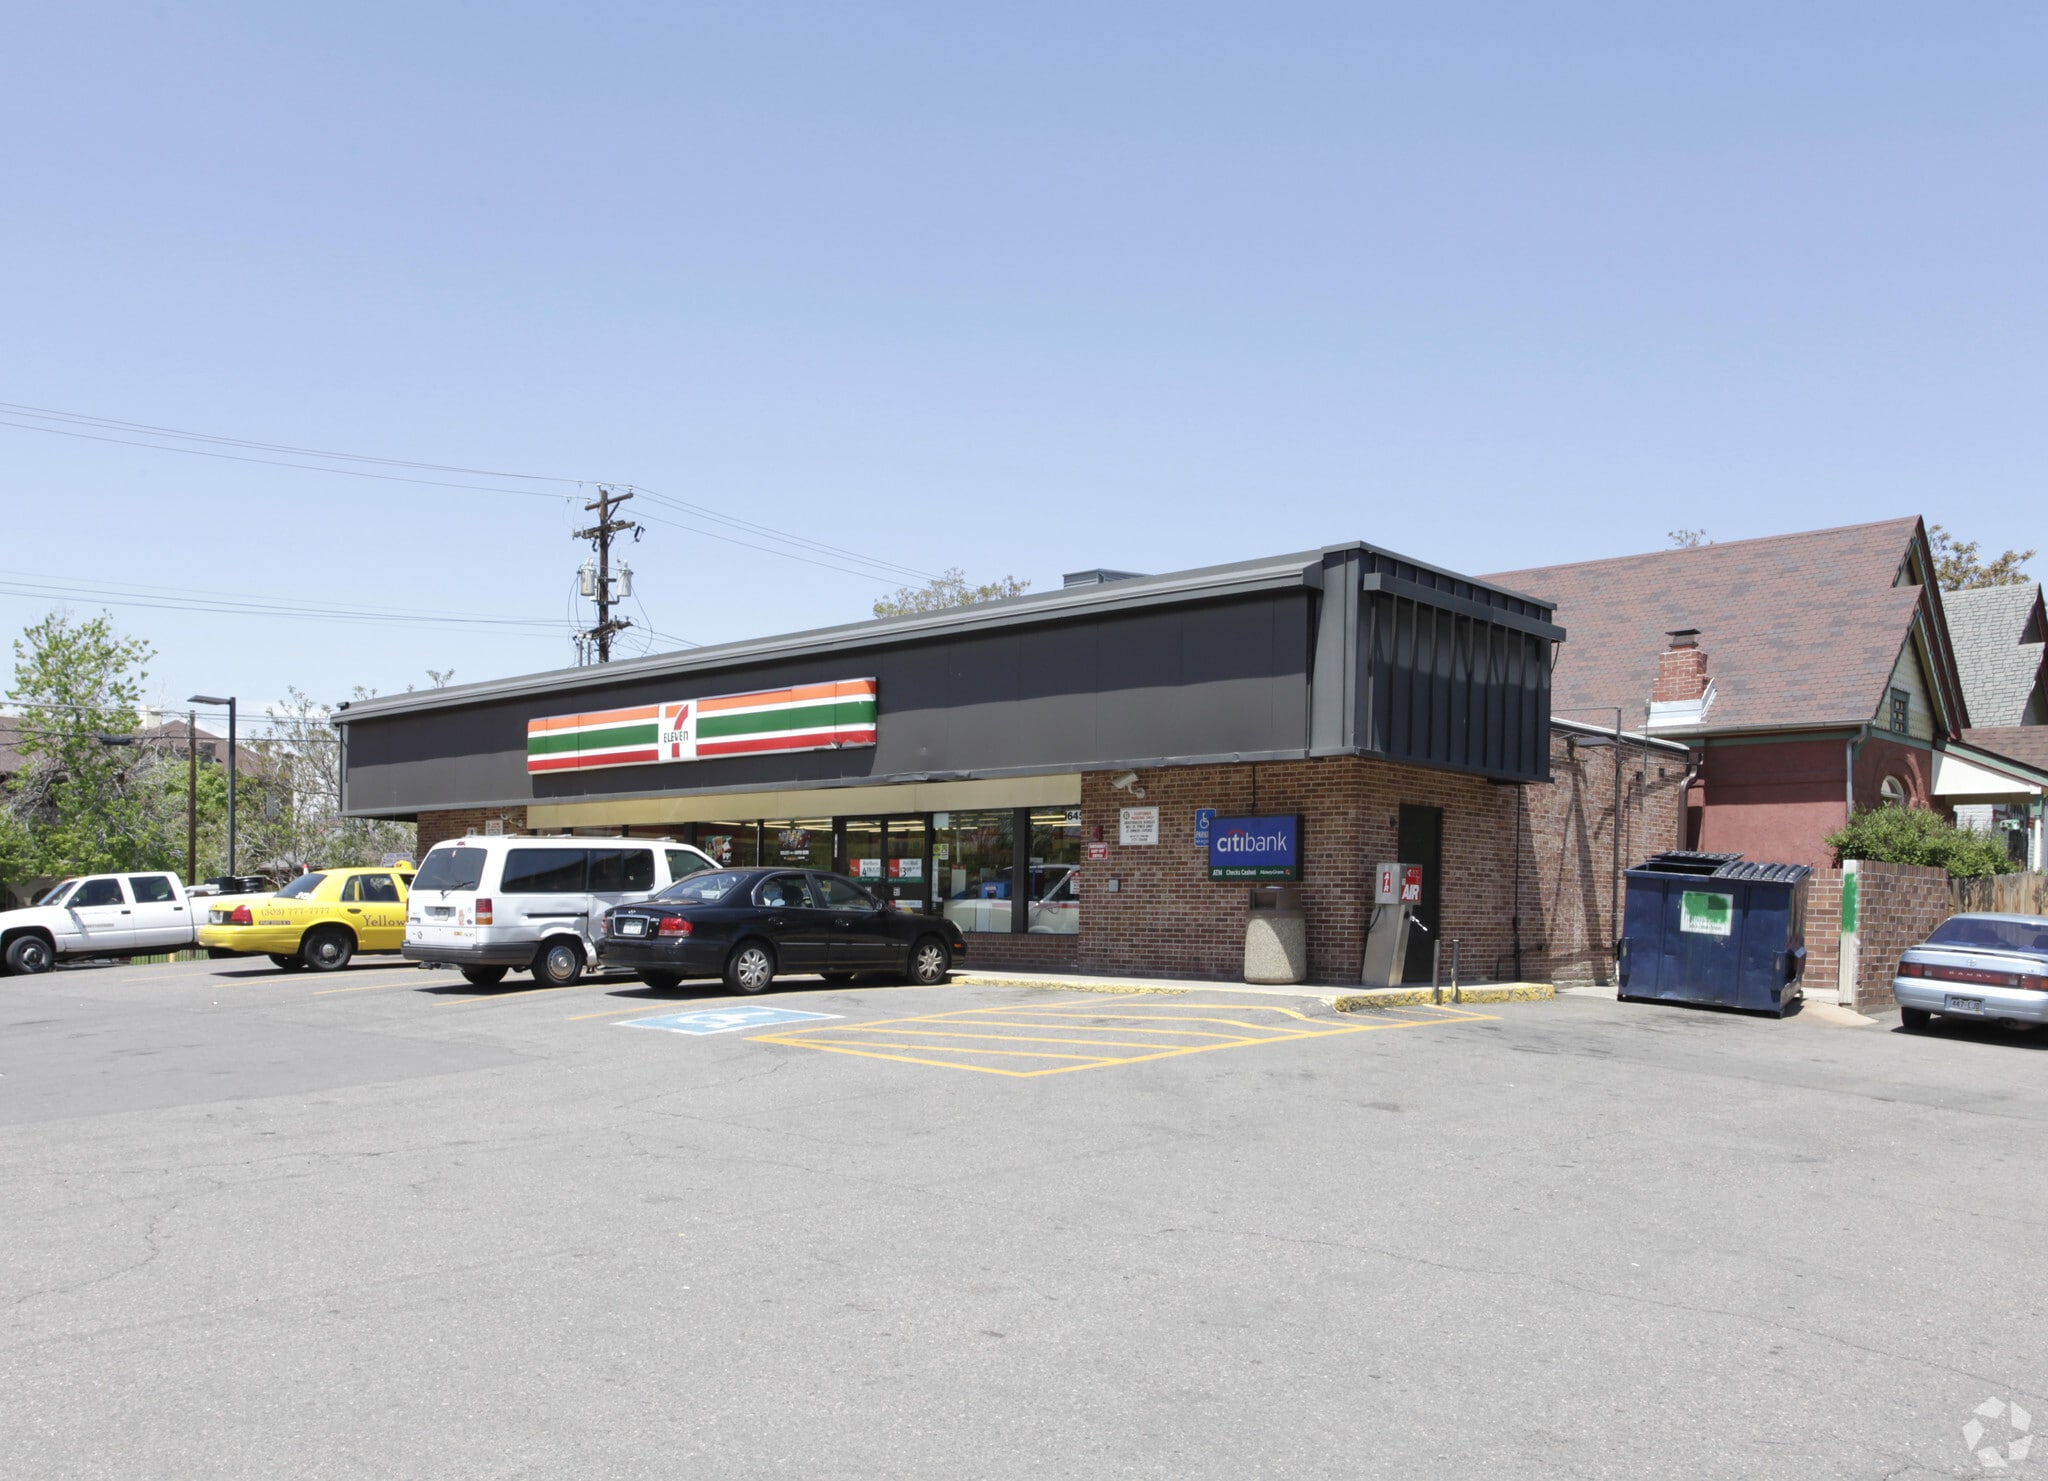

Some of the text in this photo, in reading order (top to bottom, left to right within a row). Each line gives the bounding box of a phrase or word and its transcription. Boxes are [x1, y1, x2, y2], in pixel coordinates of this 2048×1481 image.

[665, 704, 689, 758] 7
[1217, 832, 1287, 852] citibank
[1402, 884, 1420, 900] AIR
[261, 907, 330, 917] (303) 777-7777
[363, 915, 406, 927] Yellow
